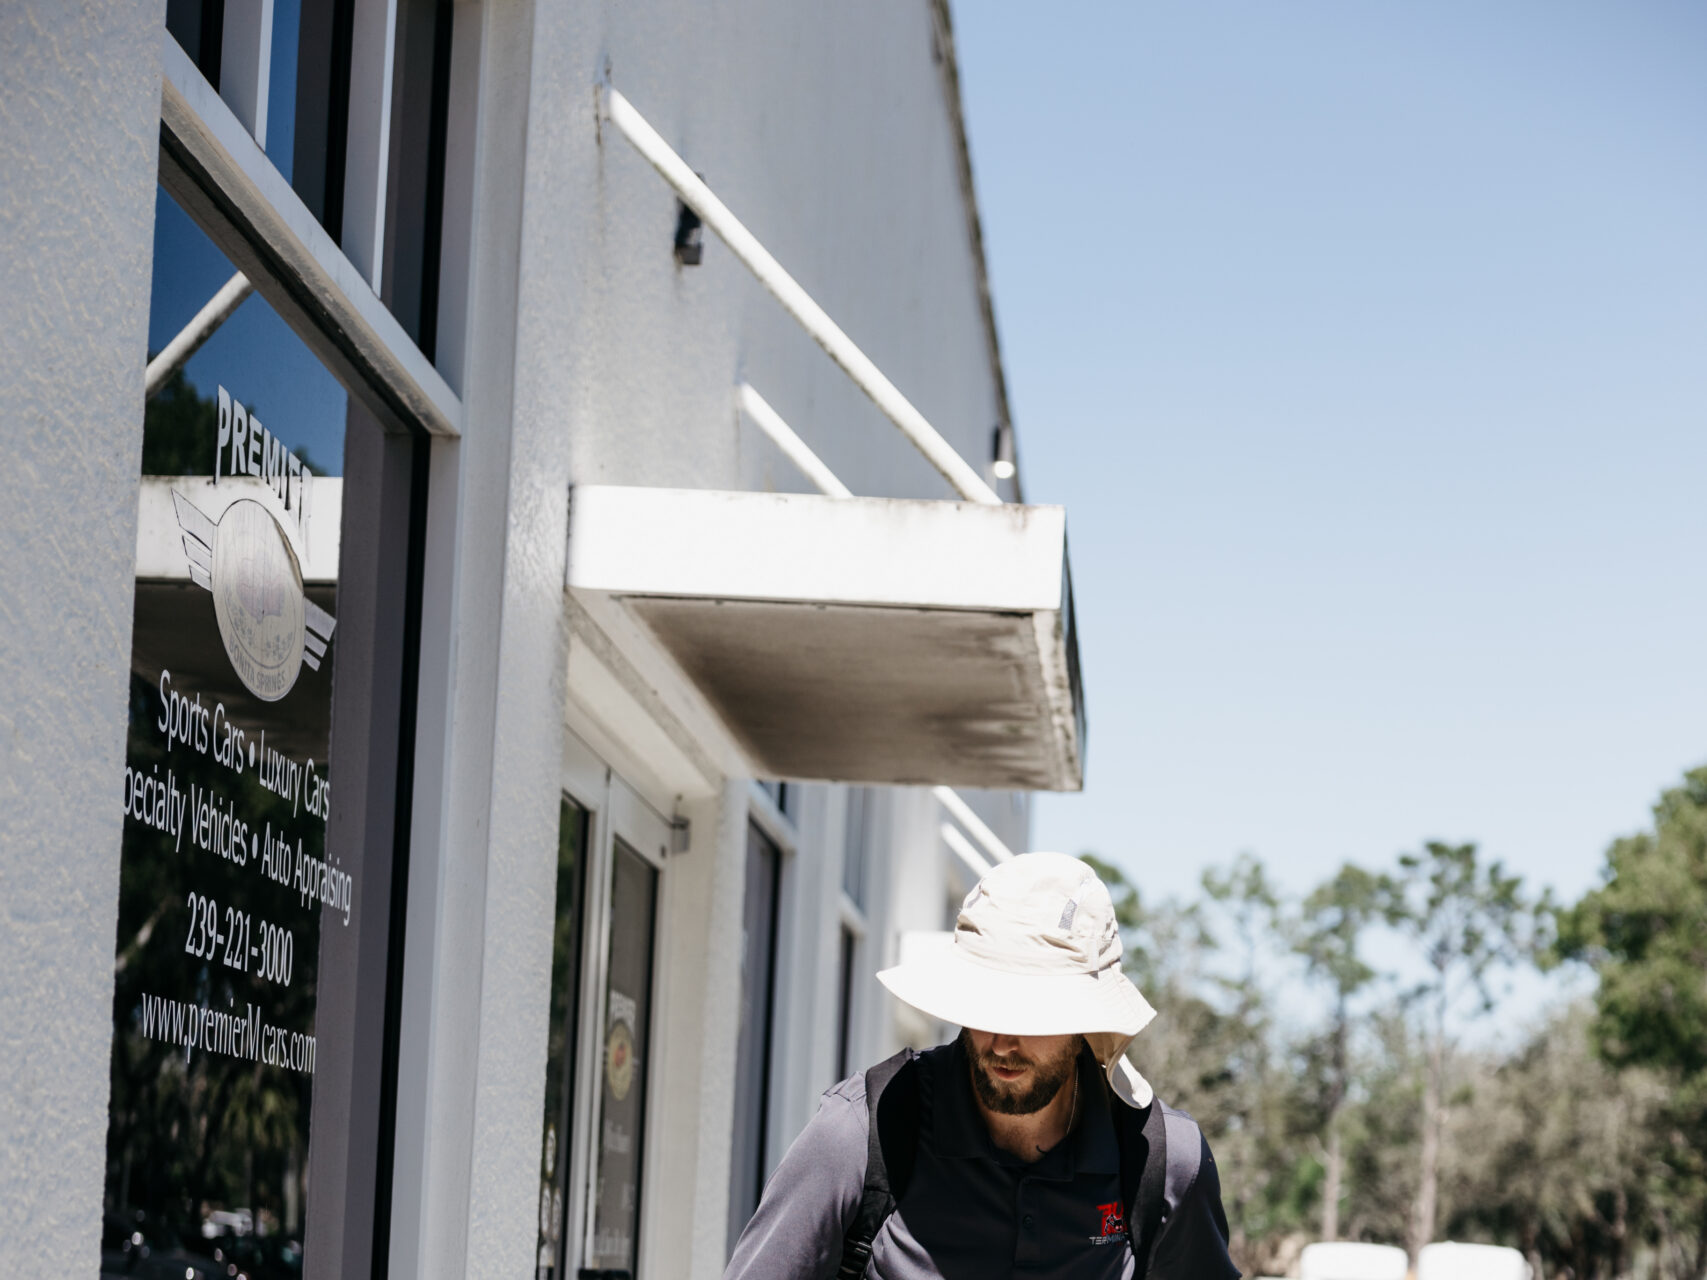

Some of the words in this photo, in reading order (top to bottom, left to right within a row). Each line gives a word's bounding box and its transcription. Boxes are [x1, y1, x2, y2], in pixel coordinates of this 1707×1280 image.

[158, 670, 209, 753] Sports
[213, 703, 245, 773] Cars
[260, 731, 302, 818] Luxury
[304, 759, 331, 821] Cars
[124, 764, 186, 853] pecialty
[191, 784, 248, 867] Vehicles
[261, 822, 292, 887] Auto
[294, 839, 352, 926] Appraising
[185, 892, 293, 986] 239-221-3000
